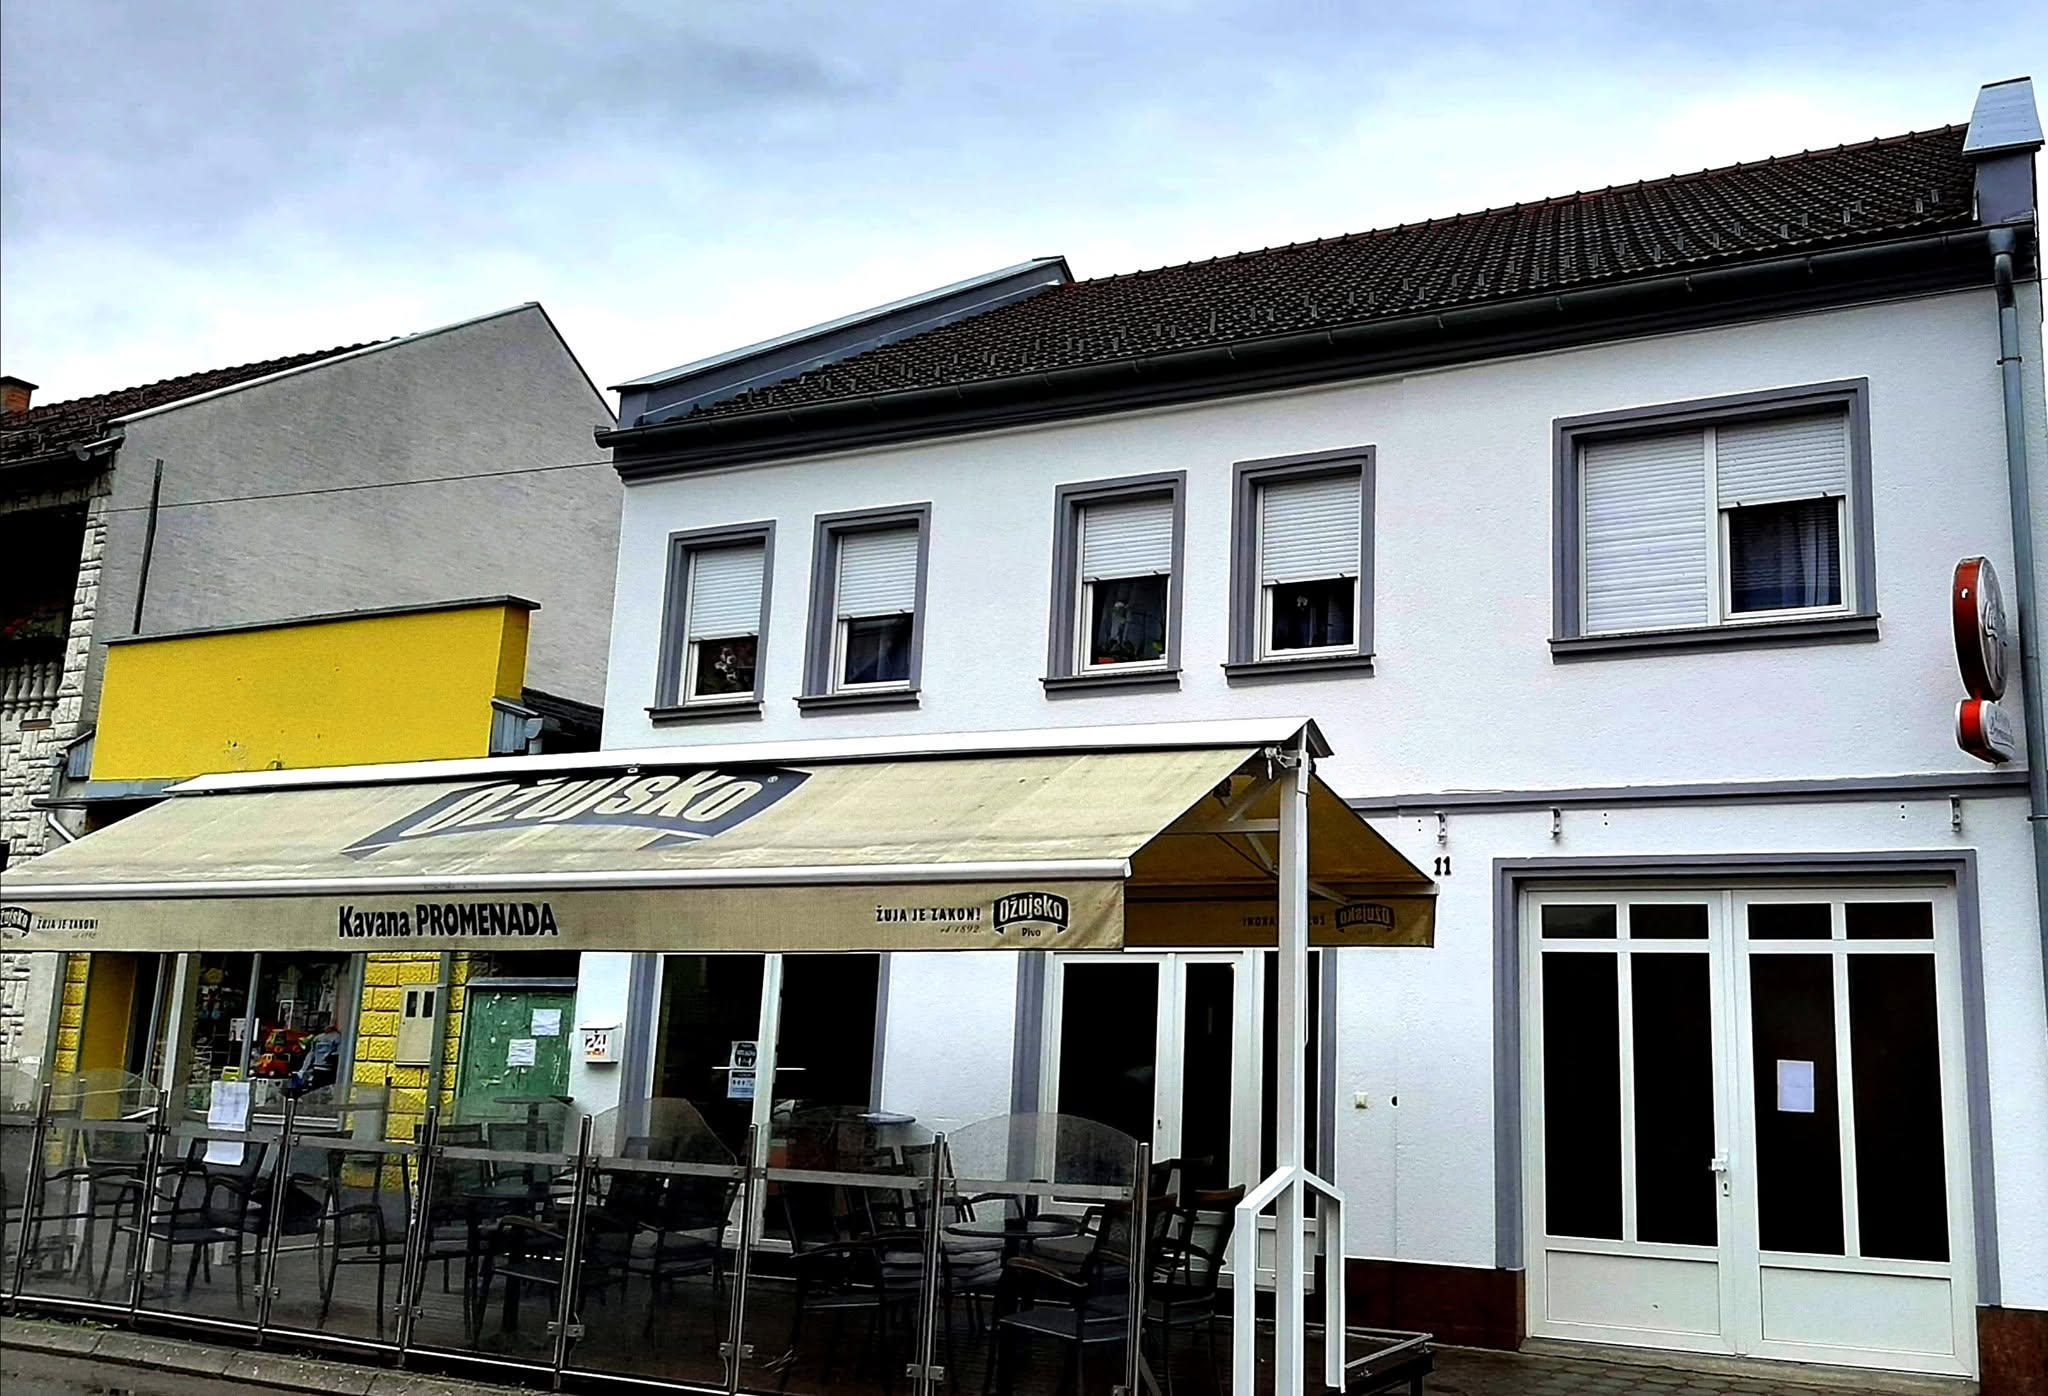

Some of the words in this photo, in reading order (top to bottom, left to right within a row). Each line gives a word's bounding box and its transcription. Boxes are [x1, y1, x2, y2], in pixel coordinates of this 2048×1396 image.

[1434, 856, 1451, 875] 11
[339, 906, 410, 937] Kavana
[416, 903, 558, 936] PROMENADA
[876, 905, 907, 922] ŽUJA
[912, 908, 926, 922] JE
[932, 907, 981, 921] ZAKON!
